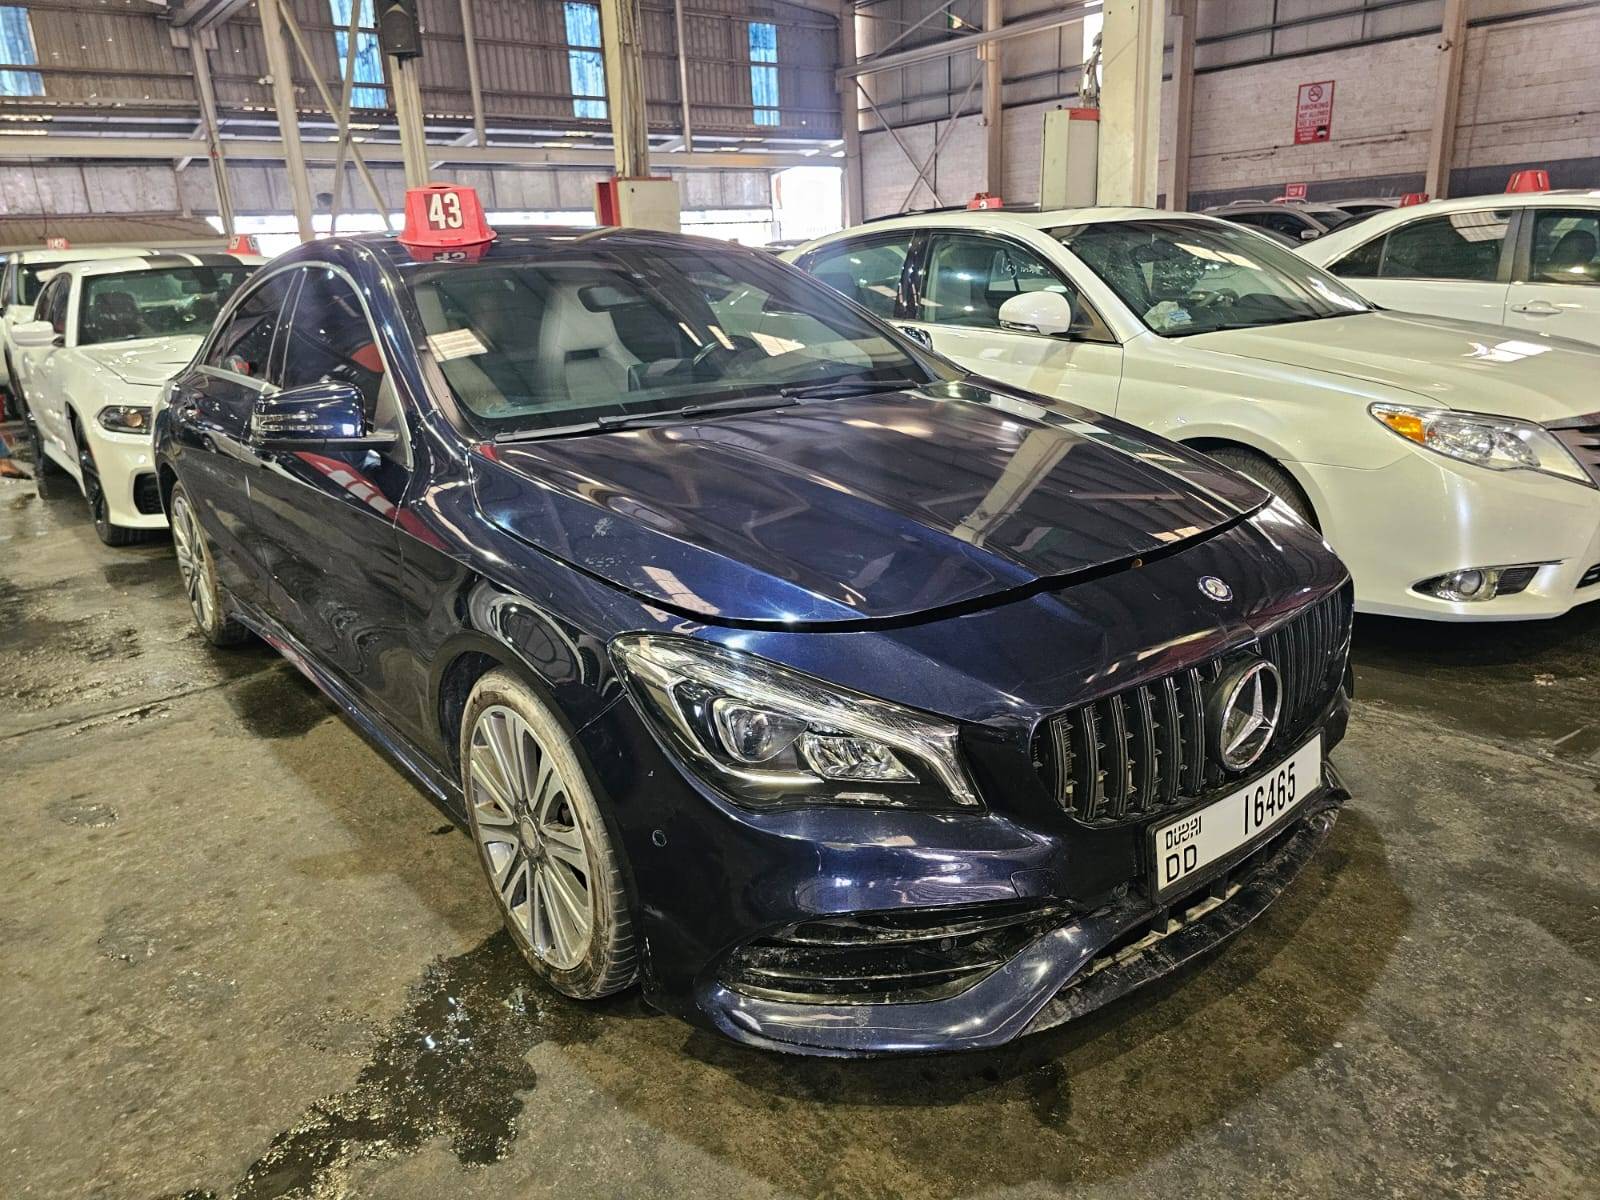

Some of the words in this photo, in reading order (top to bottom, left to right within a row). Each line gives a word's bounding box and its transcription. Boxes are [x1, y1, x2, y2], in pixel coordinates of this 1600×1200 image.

[1300, 101, 1329, 111] SMOKING
[429, 192, 463, 230] 43
[1244, 761, 1296, 835] 16465
[1166, 844, 1197, 883] DD
